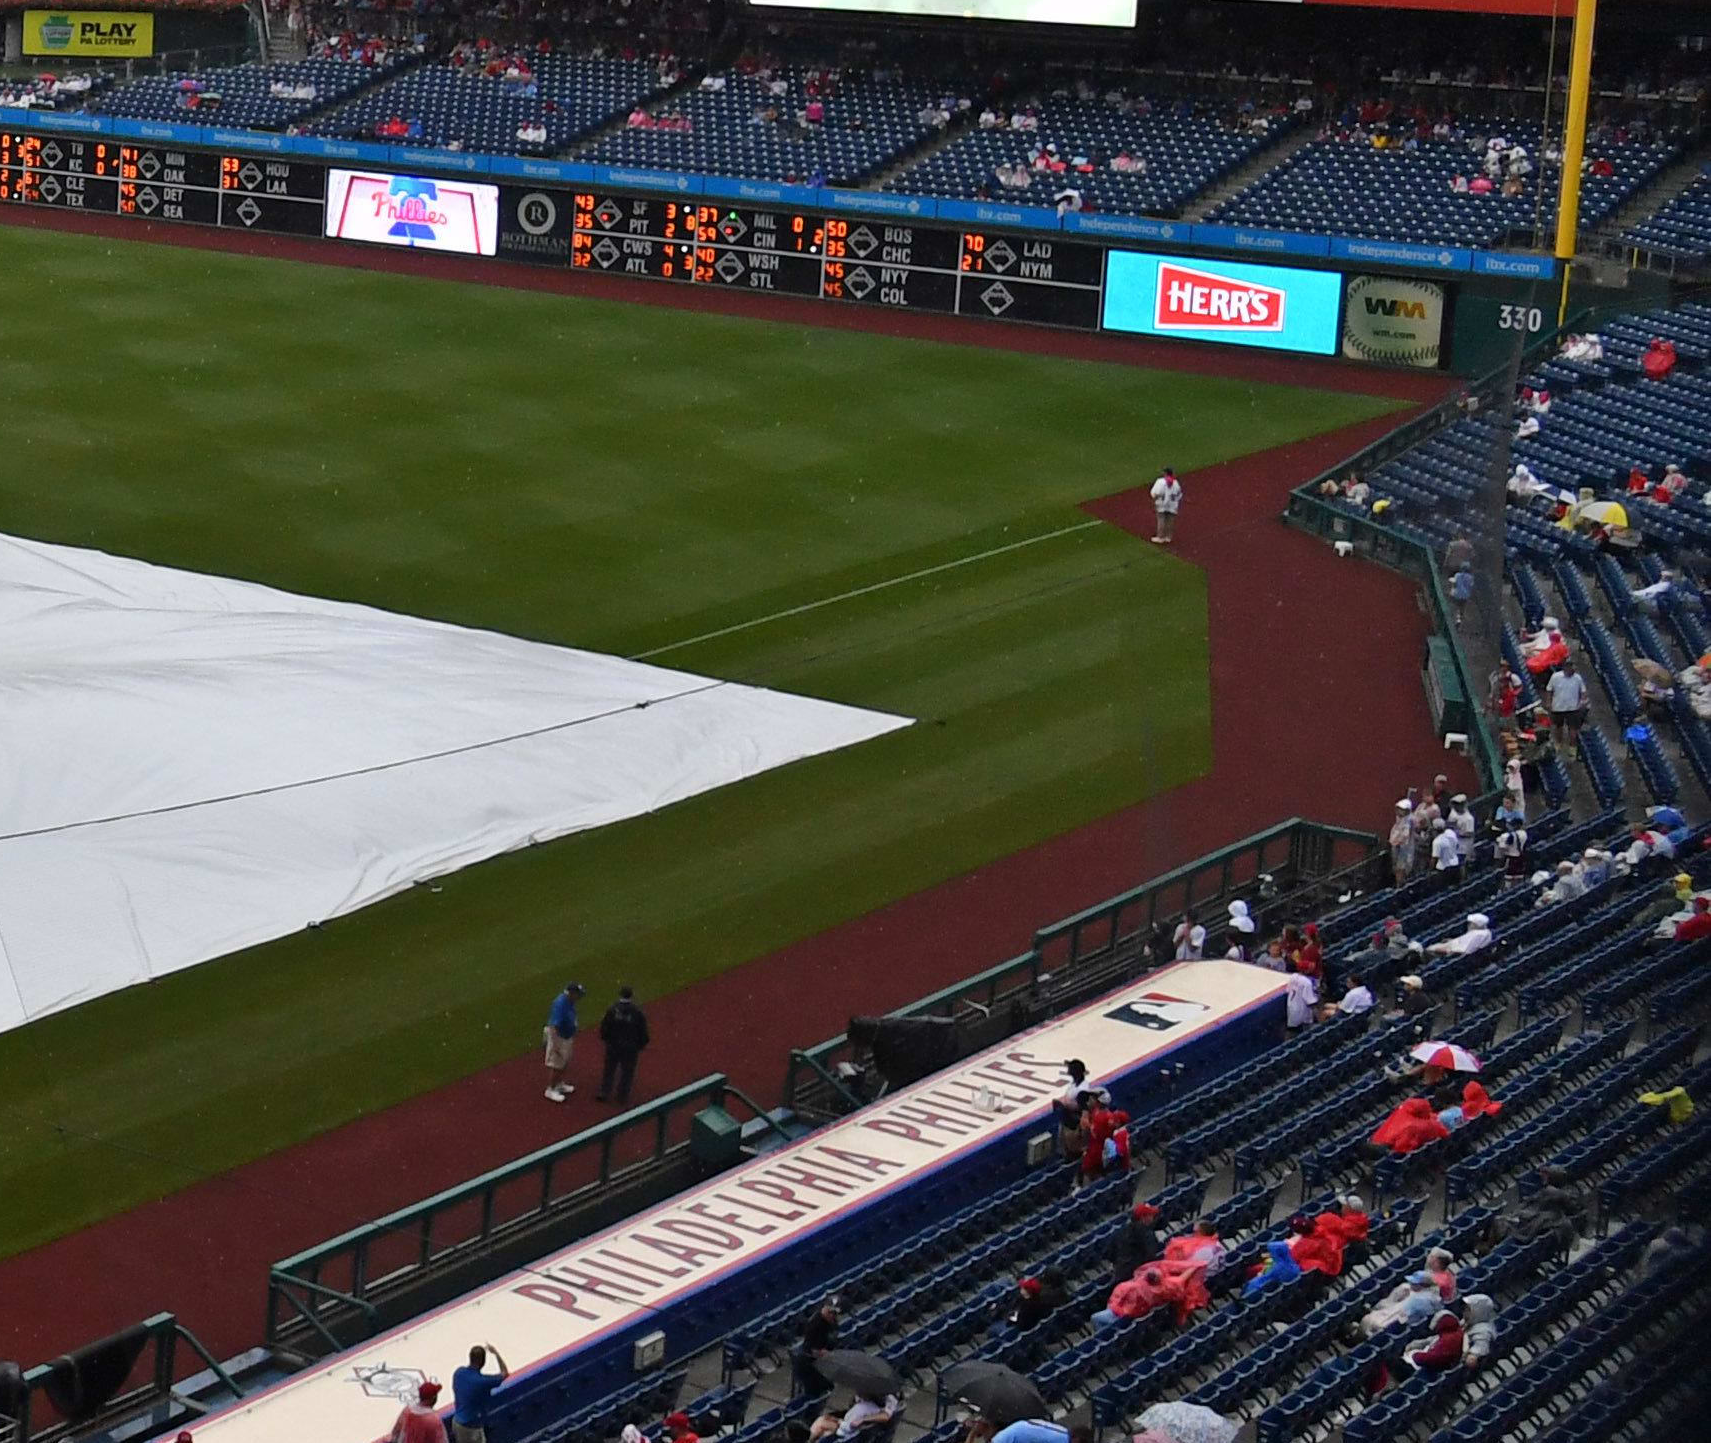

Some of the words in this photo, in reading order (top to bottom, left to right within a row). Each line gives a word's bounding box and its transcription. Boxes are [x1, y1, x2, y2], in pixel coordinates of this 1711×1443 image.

[80, 22, 138, 38] PLAY
[95, 38, 137, 47] LOTTERY
[70, 142, 84, 156] TB
[69, 159, 83, 172] KC
[223, 157, 240, 172] 53
[265, 163, 290, 178] HOU
[66, 177, 85, 191] CLE
[163, 168, 185, 183] OAK
[163, 187, 184, 202] DET
[266, 180, 288, 195] LAA
[65, 192, 85, 207] TEX
[372, 191, 449, 226] Phillies
[575, 194, 594, 210] 43
[633, 201, 648, 216] SF
[666, 203, 676, 219] 3
[163, 205, 184, 219] SEA
[530, 206, 544, 221] R
[699, 207, 718, 223] 37
[753, 214, 777, 230] MIL
[792, 216, 804, 233] 0
[575, 213, 593, 229] 35
[629, 219, 649, 235] PIT
[664, 223, 675, 238] 2
[828, 220, 847, 238] 50
[884, 227, 913, 244] BOS
[1079, 217, 1160, 235] Independence
[698, 226, 717, 242] 59
[753, 232, 777, 248] CIN
[1235, 233, 1284, 249] ibx.com
[622, 239, 653, 256] CWS
[663, 243, 674, 258] 4
[827, 240, 846, 258] 35
[882, 246, 912, 264] CHC
[1023, 242, 1052, 259] LAD
[1347, 243, 1437, 263] Independence
[696, 246, 716, 264] 40
[747, 253, 779, 270] WSH
[962, 254, 983, 271] 21
[1020, 261, 1053, 279] NYM
[1485, 256, 1540, 274] ibx.com
[625, 258, 650, 274] ATL
[662, 262, 673, 277] 0
[825, 261, 844, 278] 45
[880, 268, 909, 285] NYY
[749, 273, 774, 289] STL
[880, 288, 908, 305] COL
[1168, 280, 1270, 323] HERR'S
[1364, 296, 1427, 320] WM
[1498, 304, 1542, 333] 330
[1372, 327, 1417, 341] wm.com
[514, 1145, 907, 1321] PHILADELPHIA
[861, 1050, 1074, 1149] PHILLIES
